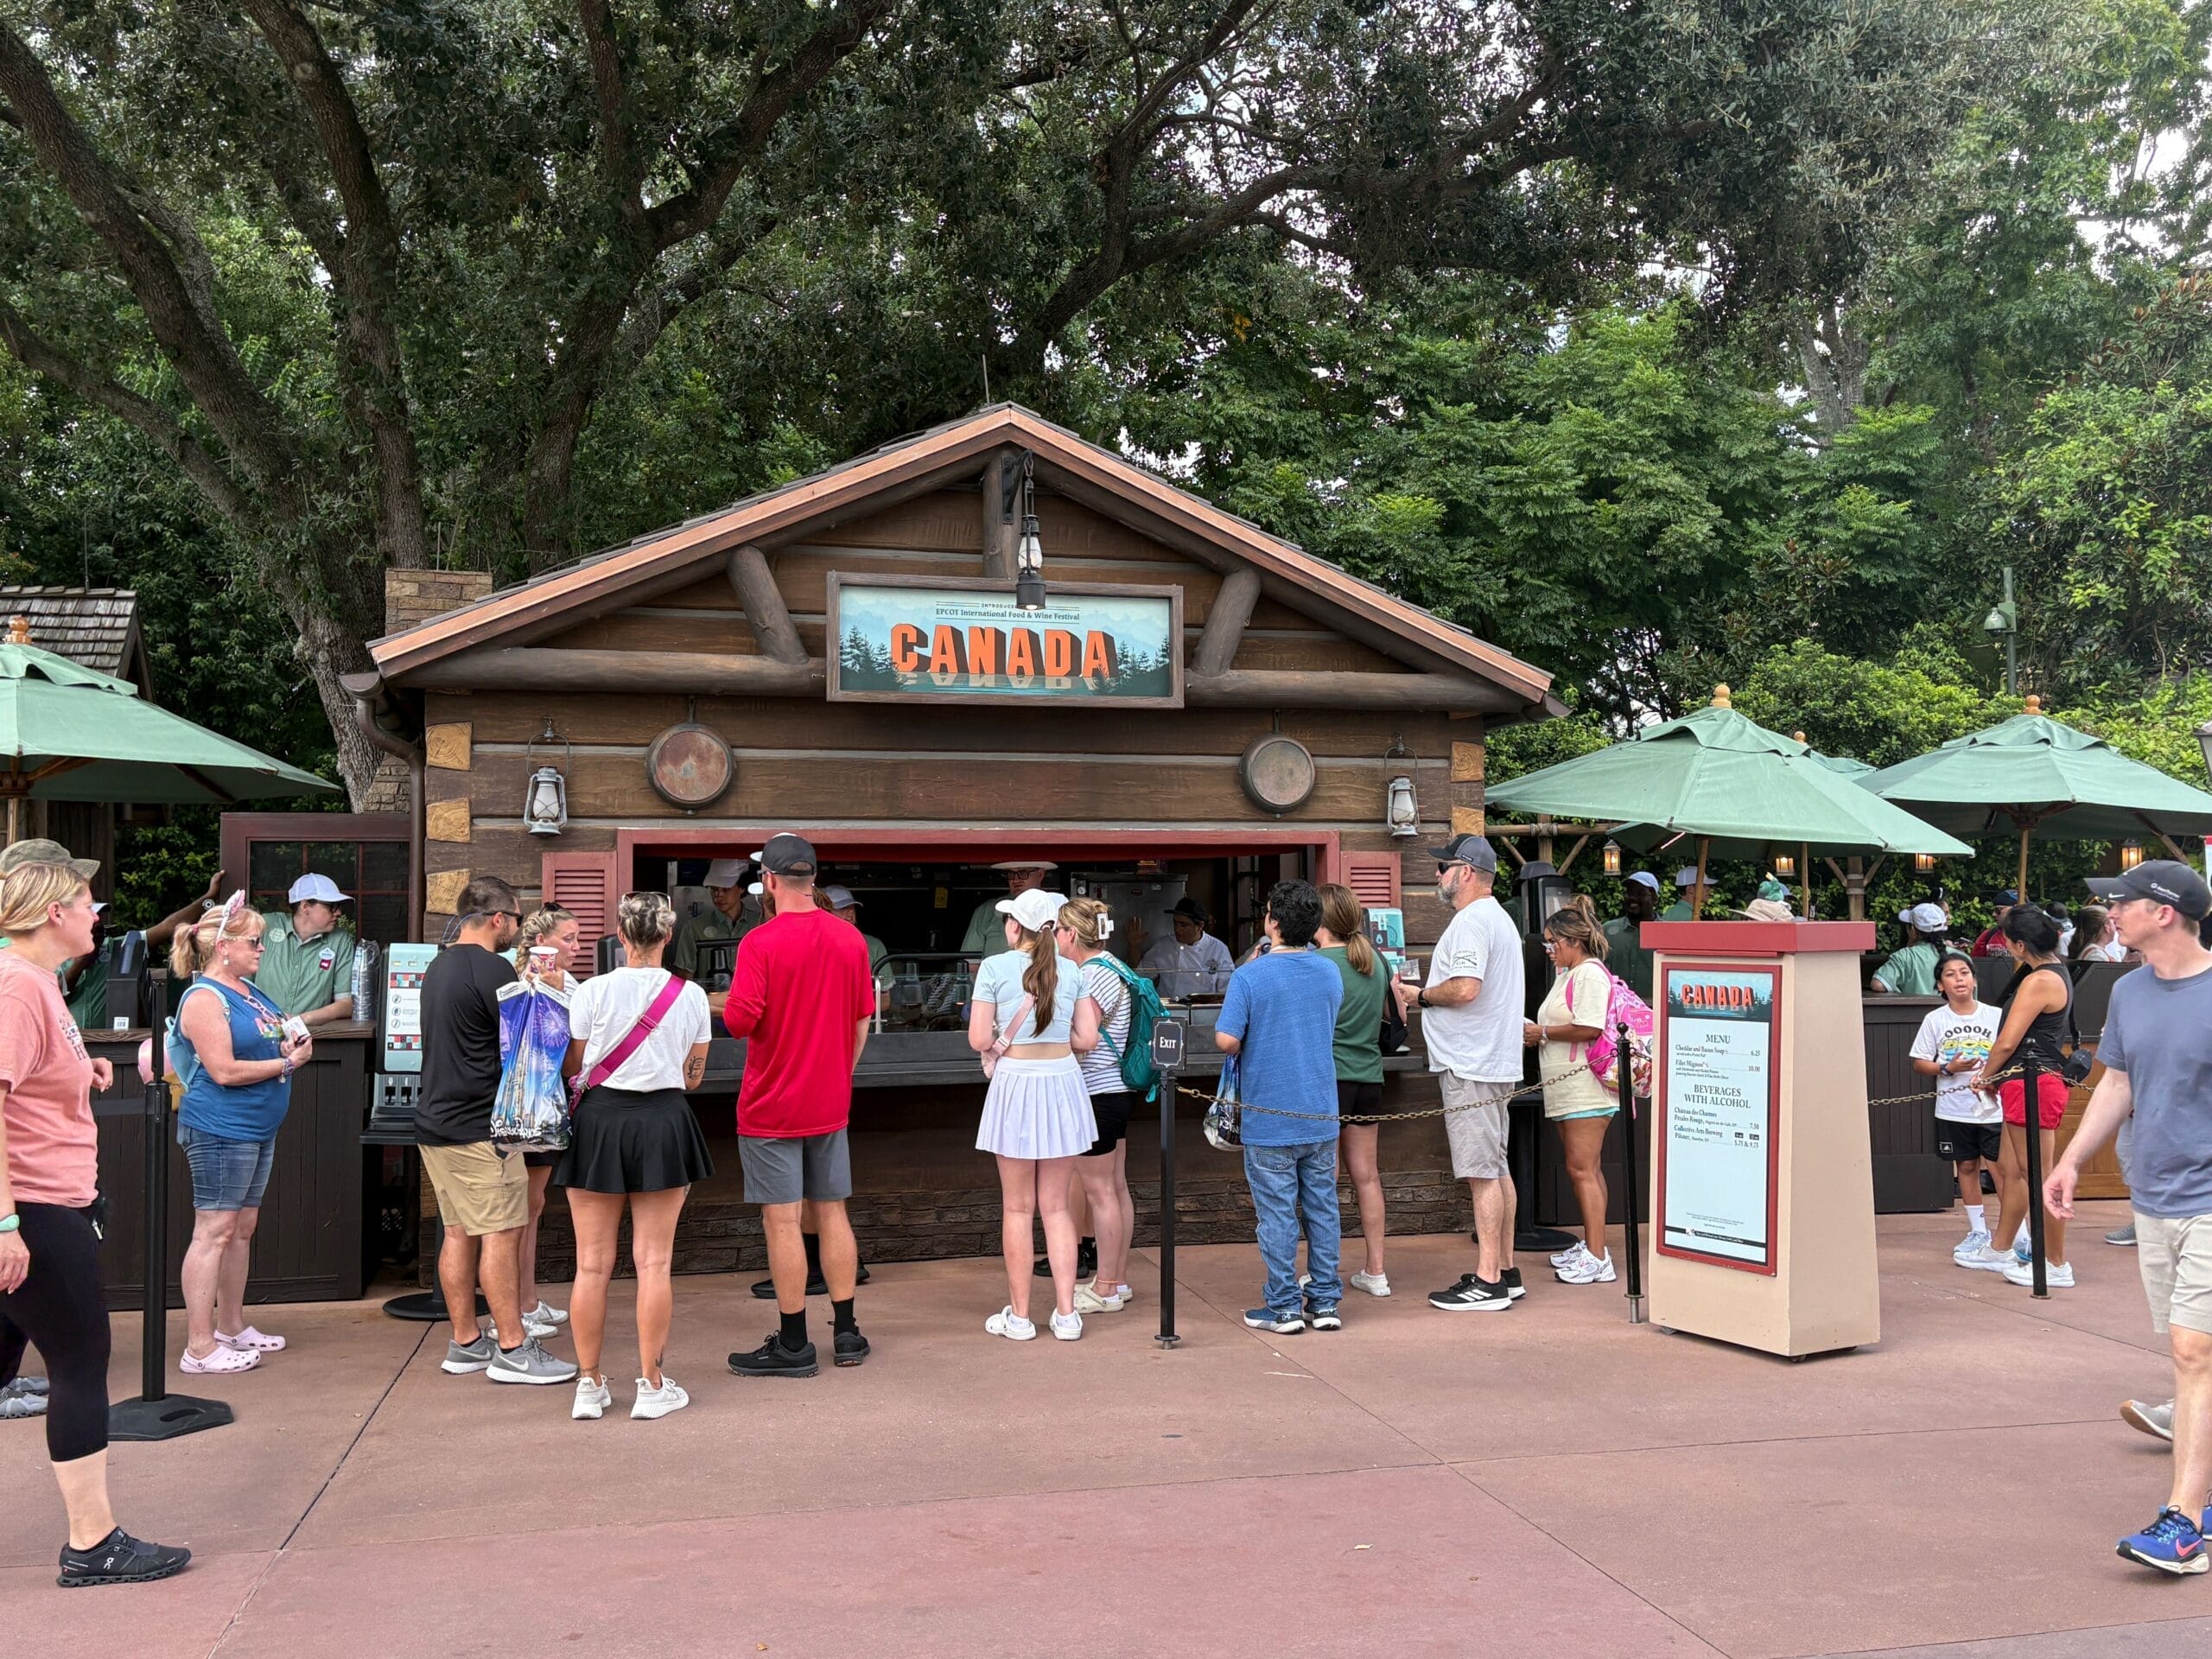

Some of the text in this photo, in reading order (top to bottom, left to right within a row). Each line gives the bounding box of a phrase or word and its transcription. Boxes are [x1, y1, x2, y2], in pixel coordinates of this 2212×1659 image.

[891, 623, 1118, 677] CANADA
[1681, 984, 1754, 1007] CANADA
[1944, 1025, 1992, 1038] OOOOH
[1706, 1034, 1731, 1044] MENU
[1714, 1046, 1726, 1055] Soup
[1694, 1084, 1741, 1096] BEVERAGES
[1684, 1094, 1751, 1109] WITH ALCOHOL
[1705, 1128, 1723, 1137] Brewing
